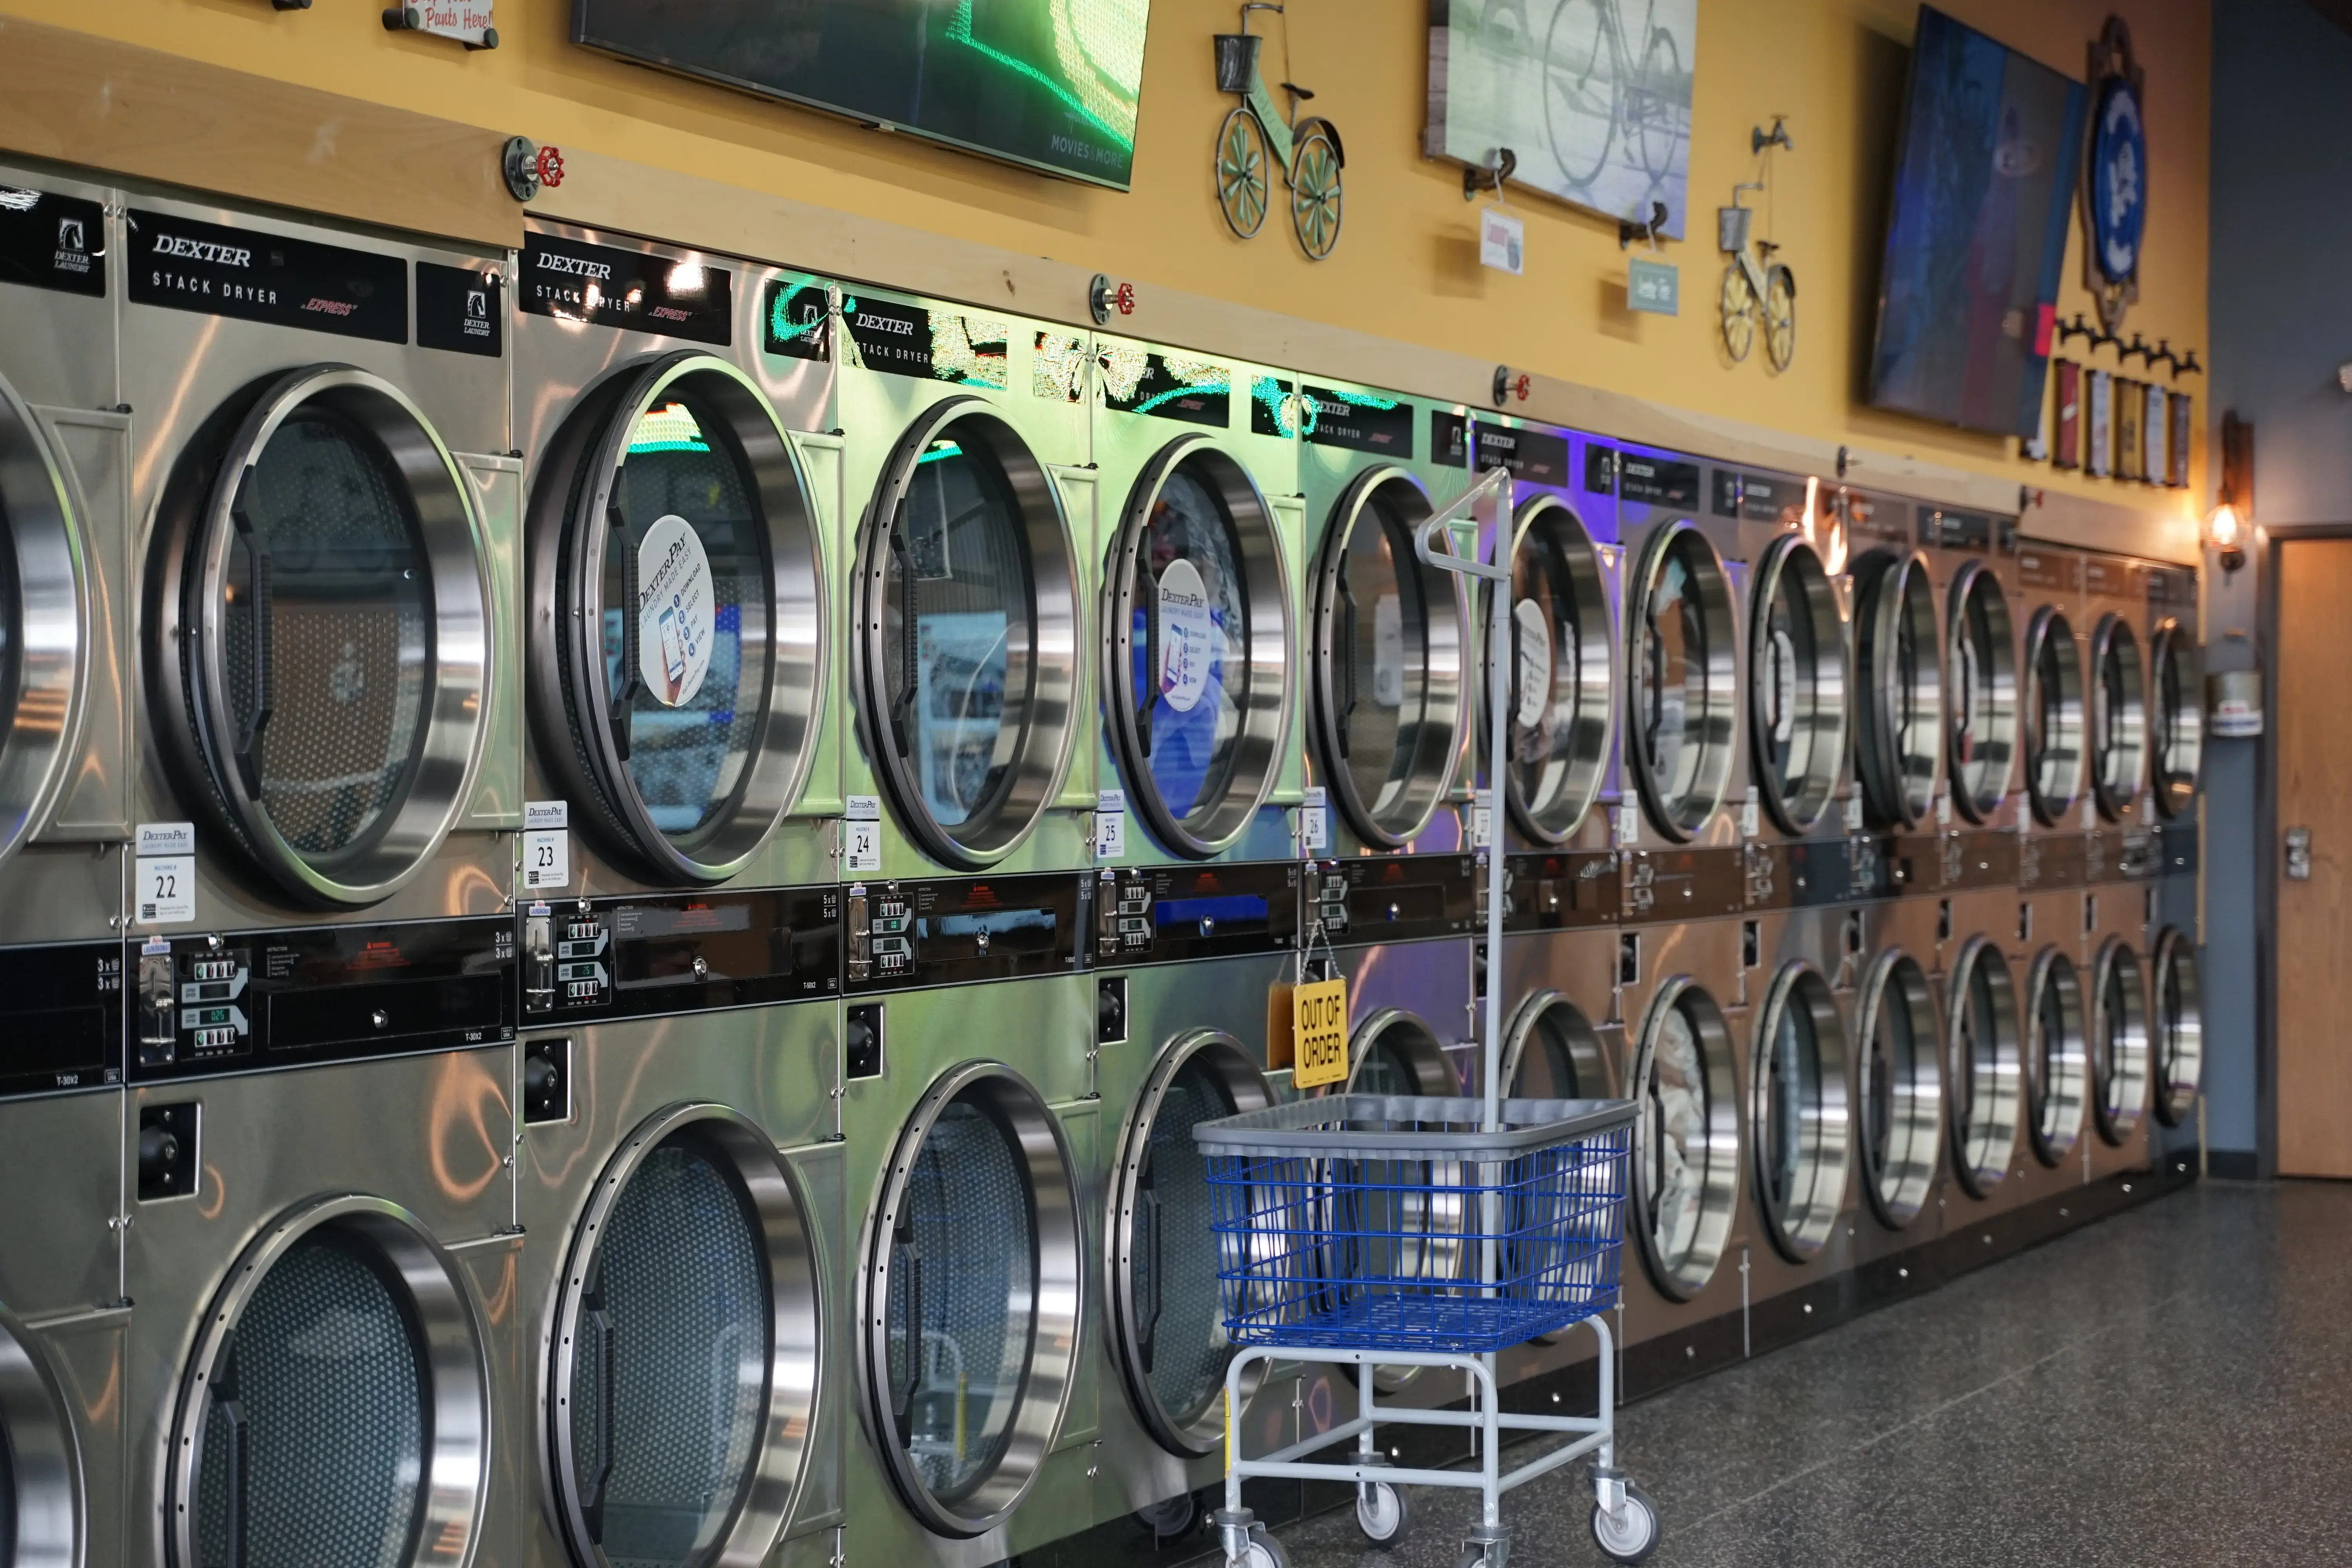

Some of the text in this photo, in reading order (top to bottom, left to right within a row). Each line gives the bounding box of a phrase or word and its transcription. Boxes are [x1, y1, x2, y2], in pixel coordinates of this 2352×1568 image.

[425, 7, 492, 30] Pants Here!
[53, 250, 90, 264] DEXTER
[152, 234, 250, 267] DEXTER
[54, 261, 91, 272] LAUNDRY
[537, 252, 611, 280] DEXTER
[153, 271, 276, 304] STACK DRYER
[536, 285, 580, 303] STACK
[306, 298, 352, 316] EXPRESS
[652, 306, 689, 321] EXPRESS
[464, 319, 490, 329] DEXTER
[464, 327, 490, 336] LAUNDRY
[856, 313, 913, 335] DEXTER
[896, 348, 928, 363] DRYER
[1315, 399, 1350, 417] EXTER
[1316, 423, 1334, 435] TACK
[1337, 426, 1360, 439] DRYER
[1481, 432, 1515, 450] DEXTER
[640, 546, 692, 628] LAUNDRY MADE EASY
[681, 563, 701, 597] DOWNLOAD
[686, 589, 700, 613] SELECT
[695, 627, 705, 644] VIEW
[1106, 825, 1115, 841] 25
[1310, 819, 1319, 834] 26
[857, 835, 869, 853] 24
[538, 846, 554, 867] 23
[156, 875, 176, 899] 22
[1081, 879, 1084, 887] 5
[824, 895, 827, 904] 5
[1081, 891, 1084, 900] 5
[824, 909, 827, 918] 5
[495, 932, 500, 943] 3
[143, 944, 171, 953] LAUNDROMAT
[496, 947, 500, 958] 3
[586, 944, 590, 952] 5
[98, 959, 110, 972] 3 x
[583, 966, 590, 975] 25
[98, 977, 110, 990] 3 x
[1301, 995, 1341, 1031] OUT OF
[466, 1033, 482, 1042] T-30X2
[1303, 1032, 1341, 1069] ORDER
[56, 1074, 79, 1087] T-30X2
